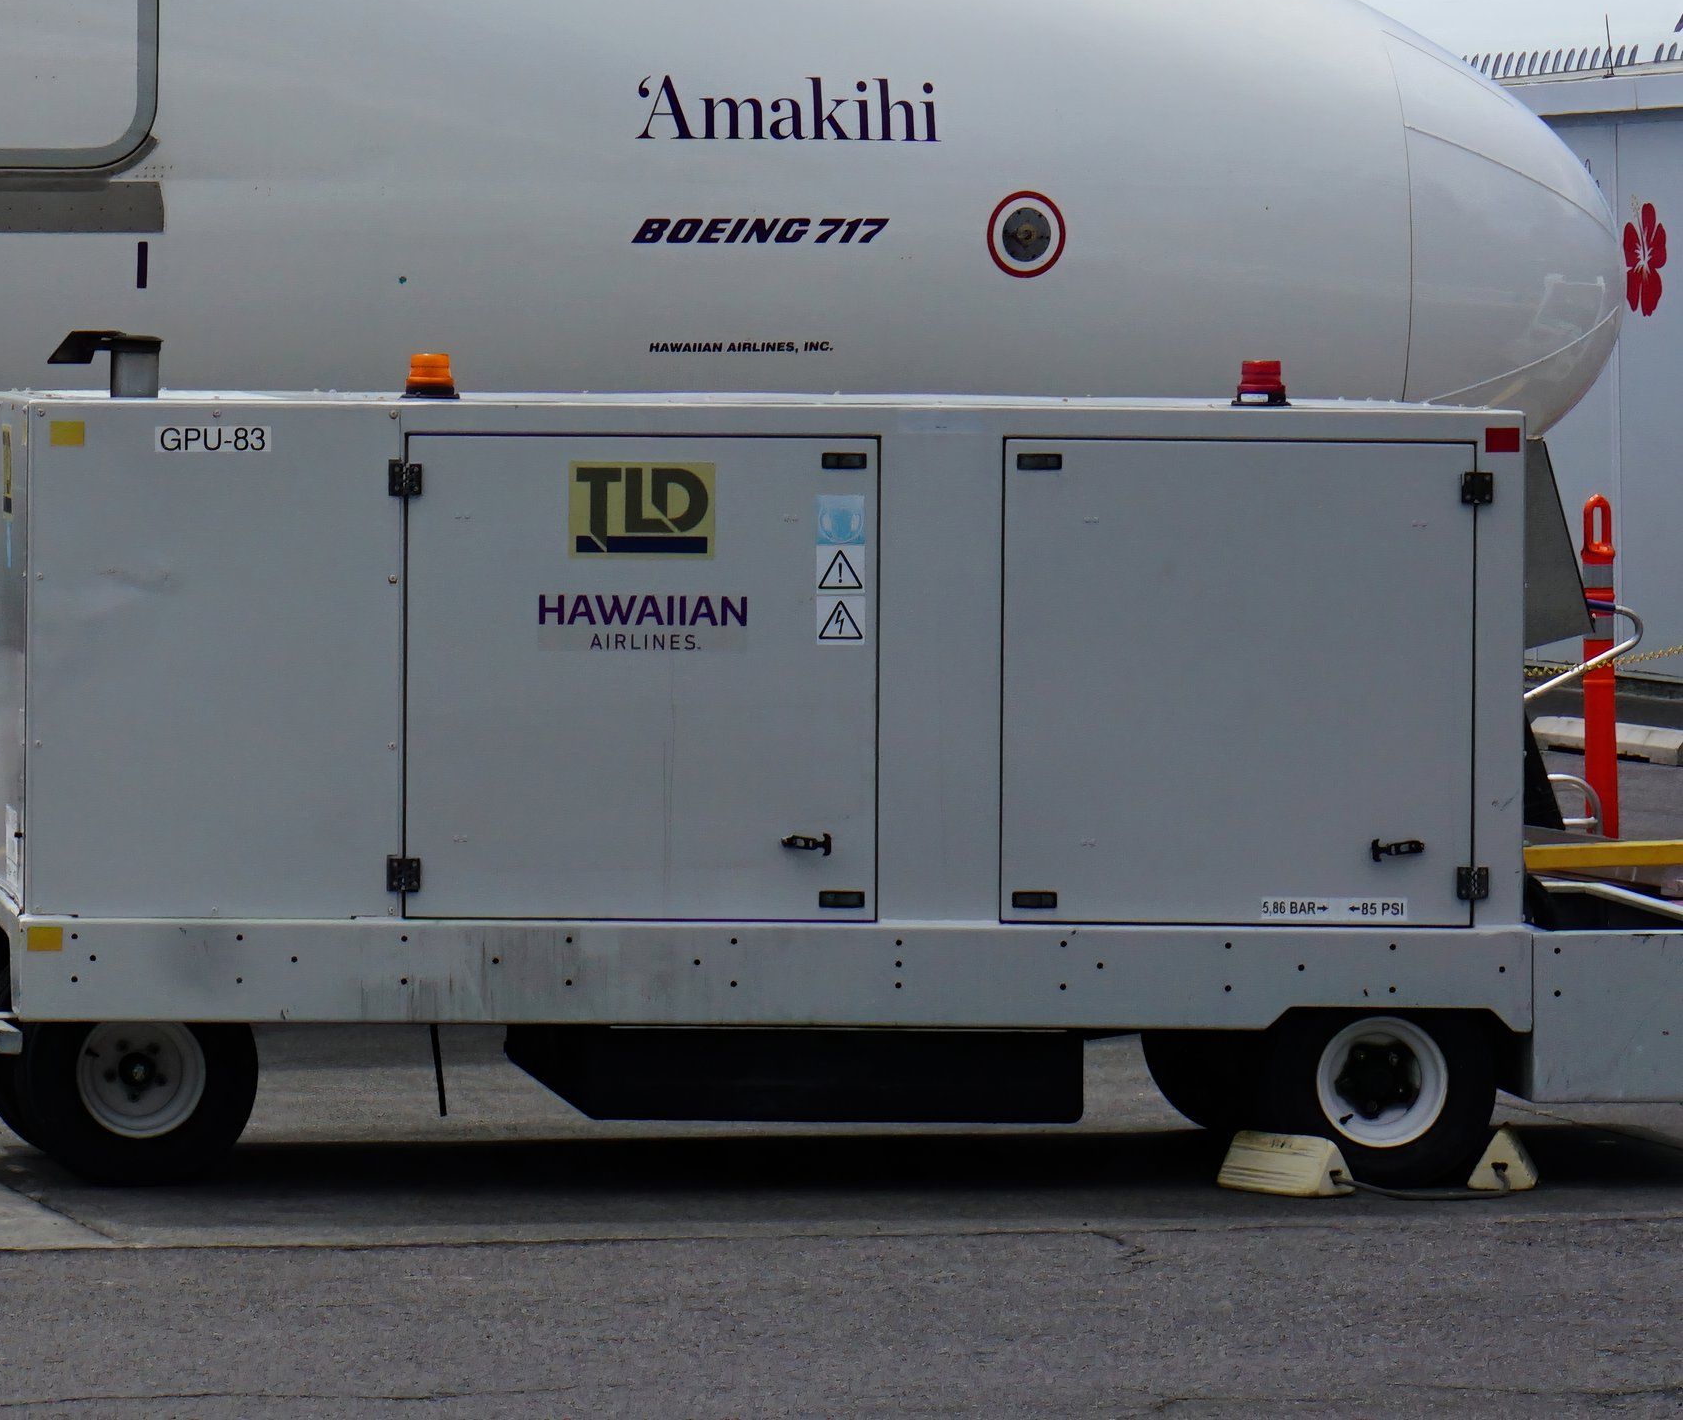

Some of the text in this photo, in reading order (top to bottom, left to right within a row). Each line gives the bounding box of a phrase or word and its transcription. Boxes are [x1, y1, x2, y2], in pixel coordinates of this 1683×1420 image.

[635, 74, 941, 143] ‘Amakihi
[631, 217, 890, 245] BOEING 717
[649, 340, 834, 354] HAWAIIAN AIRLINES, INC.
[160, 427, 266, 451] GPU-83
[576, 467, 708, 553] TLD
[538, 594, 748, 627] HAWAIIAN
[1262, 901, 1404, 917] 5,86 BAR 85 PSI
